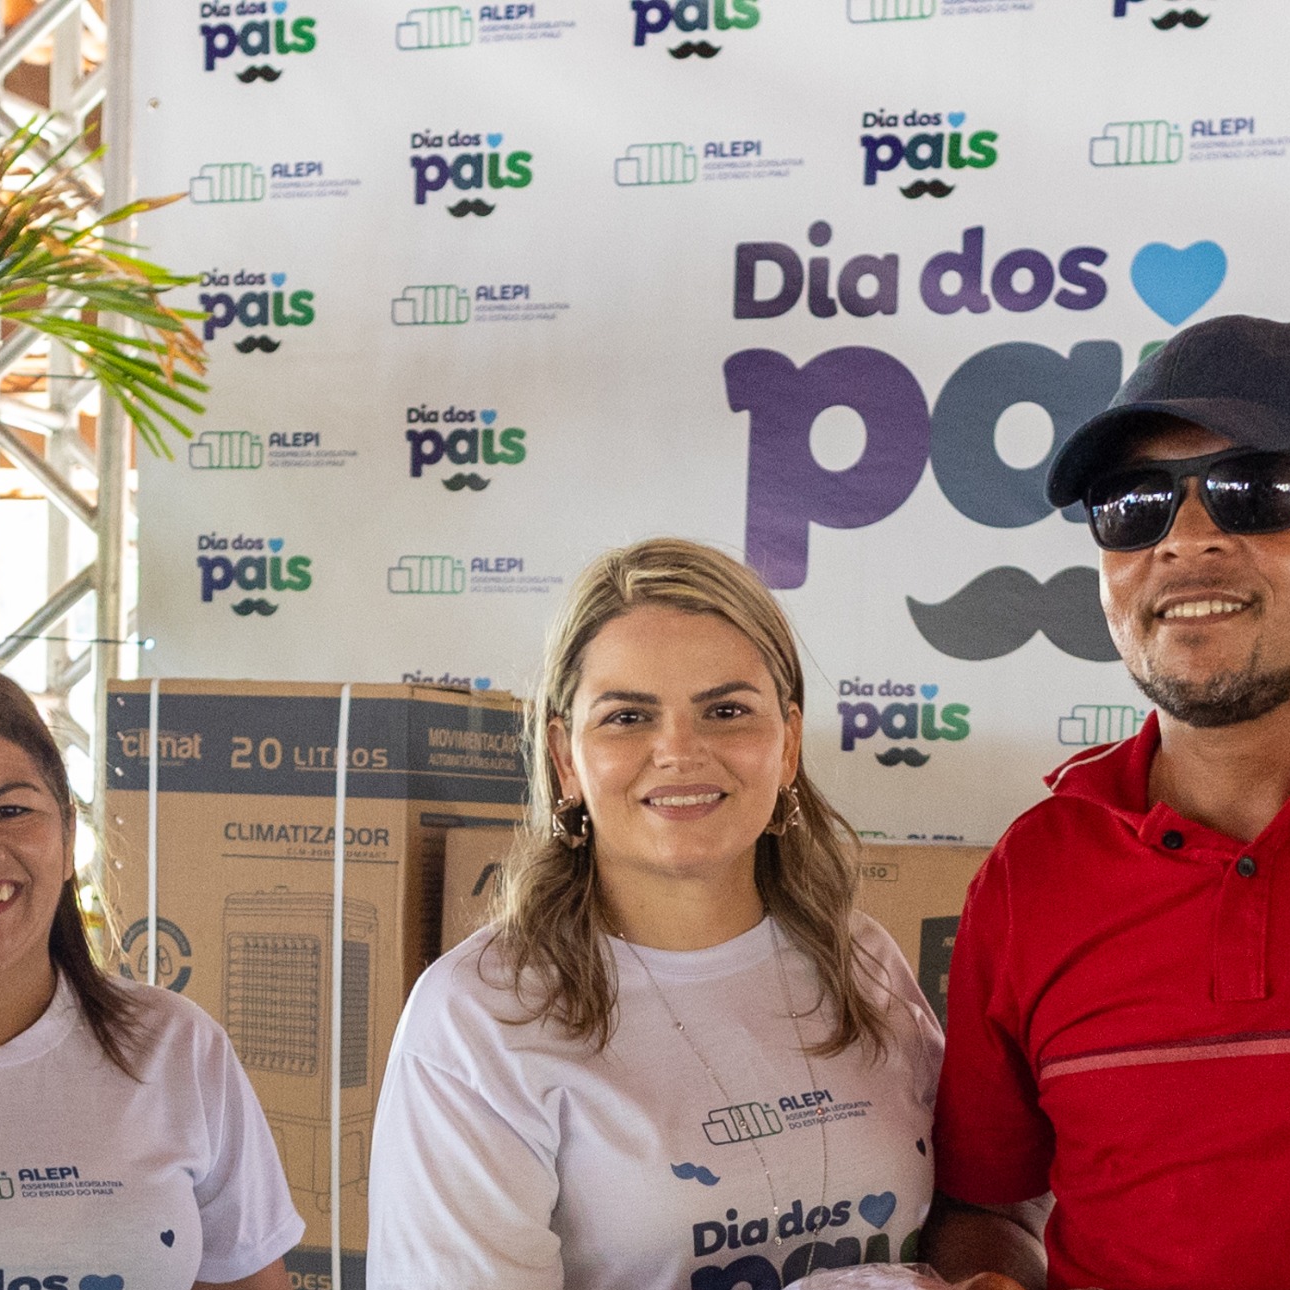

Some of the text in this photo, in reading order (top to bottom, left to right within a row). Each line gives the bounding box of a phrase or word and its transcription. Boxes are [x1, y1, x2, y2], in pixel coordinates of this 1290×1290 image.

[200, 0, 230, 18] Dia
[479, 4, 535, 20] ALEPI
[199, 16, 317, 71] pais
[862, 108, 942, 128] Dia dos
[1191, 117, 1255, 137] ALEPI
[411, 130, 481, 149] Dia dos
[704, 140, 761, 158] ALEPI
[861, 129, 998, 186] pais
[271, 162, 323, 178] ALEPI
[411, 150, 533, 205] pais
[200, 268, 266, 287] Dia dos
[733, 221, 1108, 319] Dia dos
[475, 284, 530, 301] ALEPI
[199, 288, 315, 342] pais
[406, 404, 476, 424] Dia dos
[269, 432, 321, 448] ALEPI
[406, 426, 526, 478] pais
[198, 533, 264, 552] Dia dos
[471, 557, 524, 573] ALEPI
[198, 552, 312, 602] pais
[839, 675, 916, 698] Dia dos
[837, 702, 971, 752] pais
[231, 736, 389, 770] 20 LITOS
[778, 1089, 833, 1112] ALEPI
[18, 1166, 80, 1182] ALEPI
[39, 1190, 75, 1198] ESTADO
[76, 1189, 91, 1197] DO
[692, 1199, 852, 1257] Dia dos
